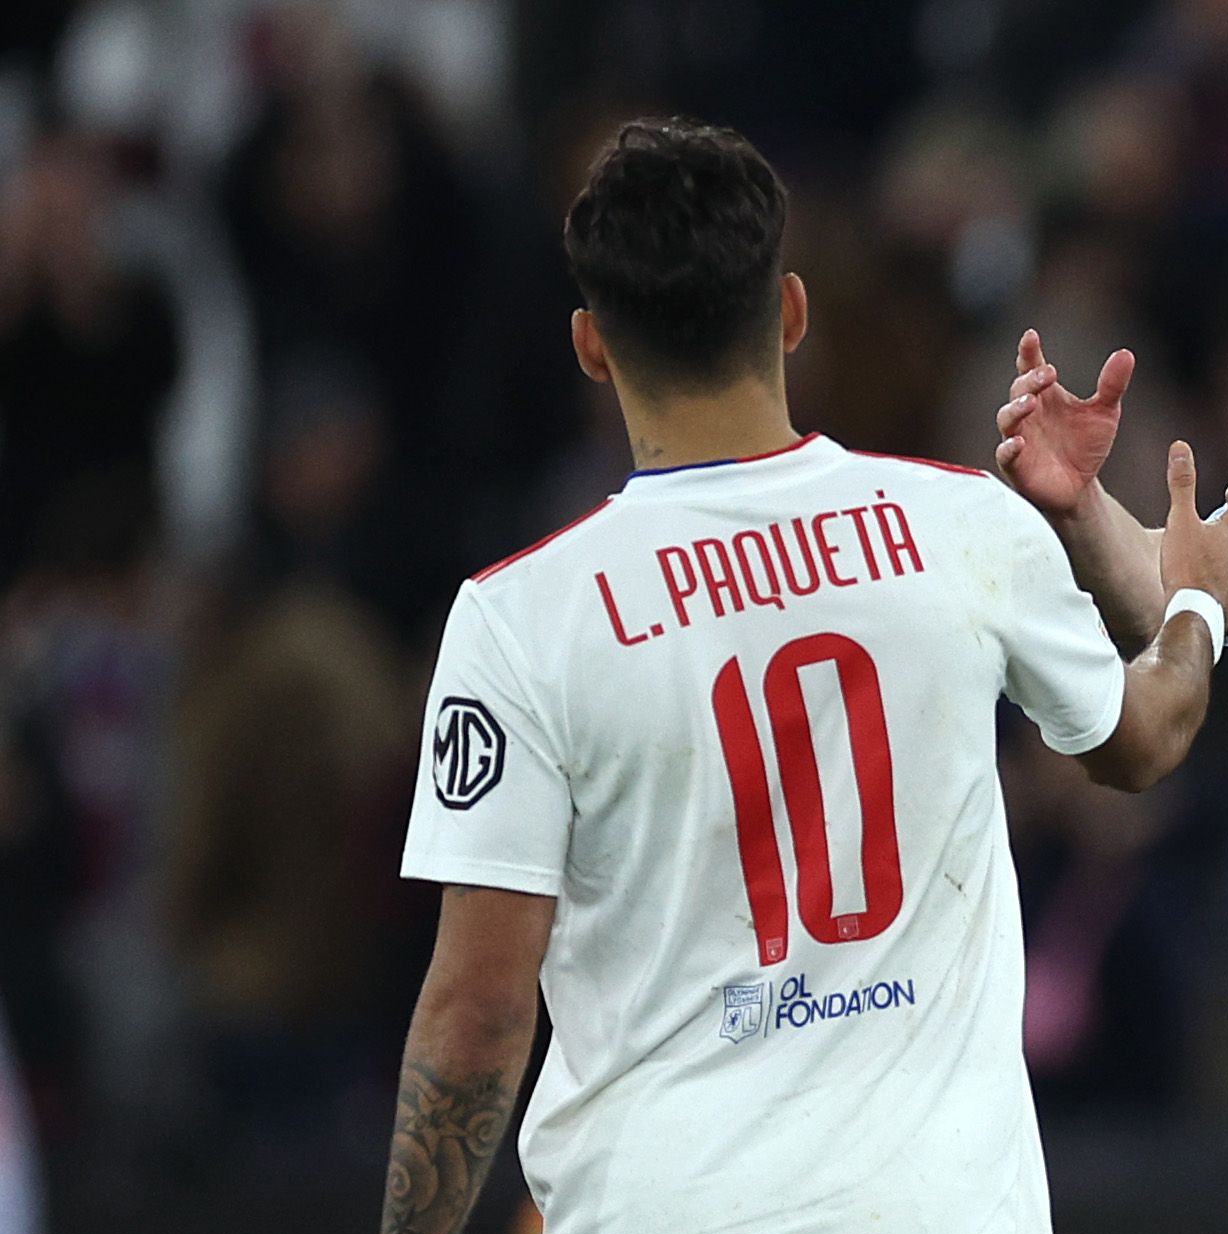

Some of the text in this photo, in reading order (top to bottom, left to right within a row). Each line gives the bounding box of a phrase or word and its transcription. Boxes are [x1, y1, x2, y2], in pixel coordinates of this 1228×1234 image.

[433, 706, 497, 799] MG
[712, 632, 904, 967] 10
[775, 979, 915, 1030] FONDATION
[780, 973, 812, 1002] OL
